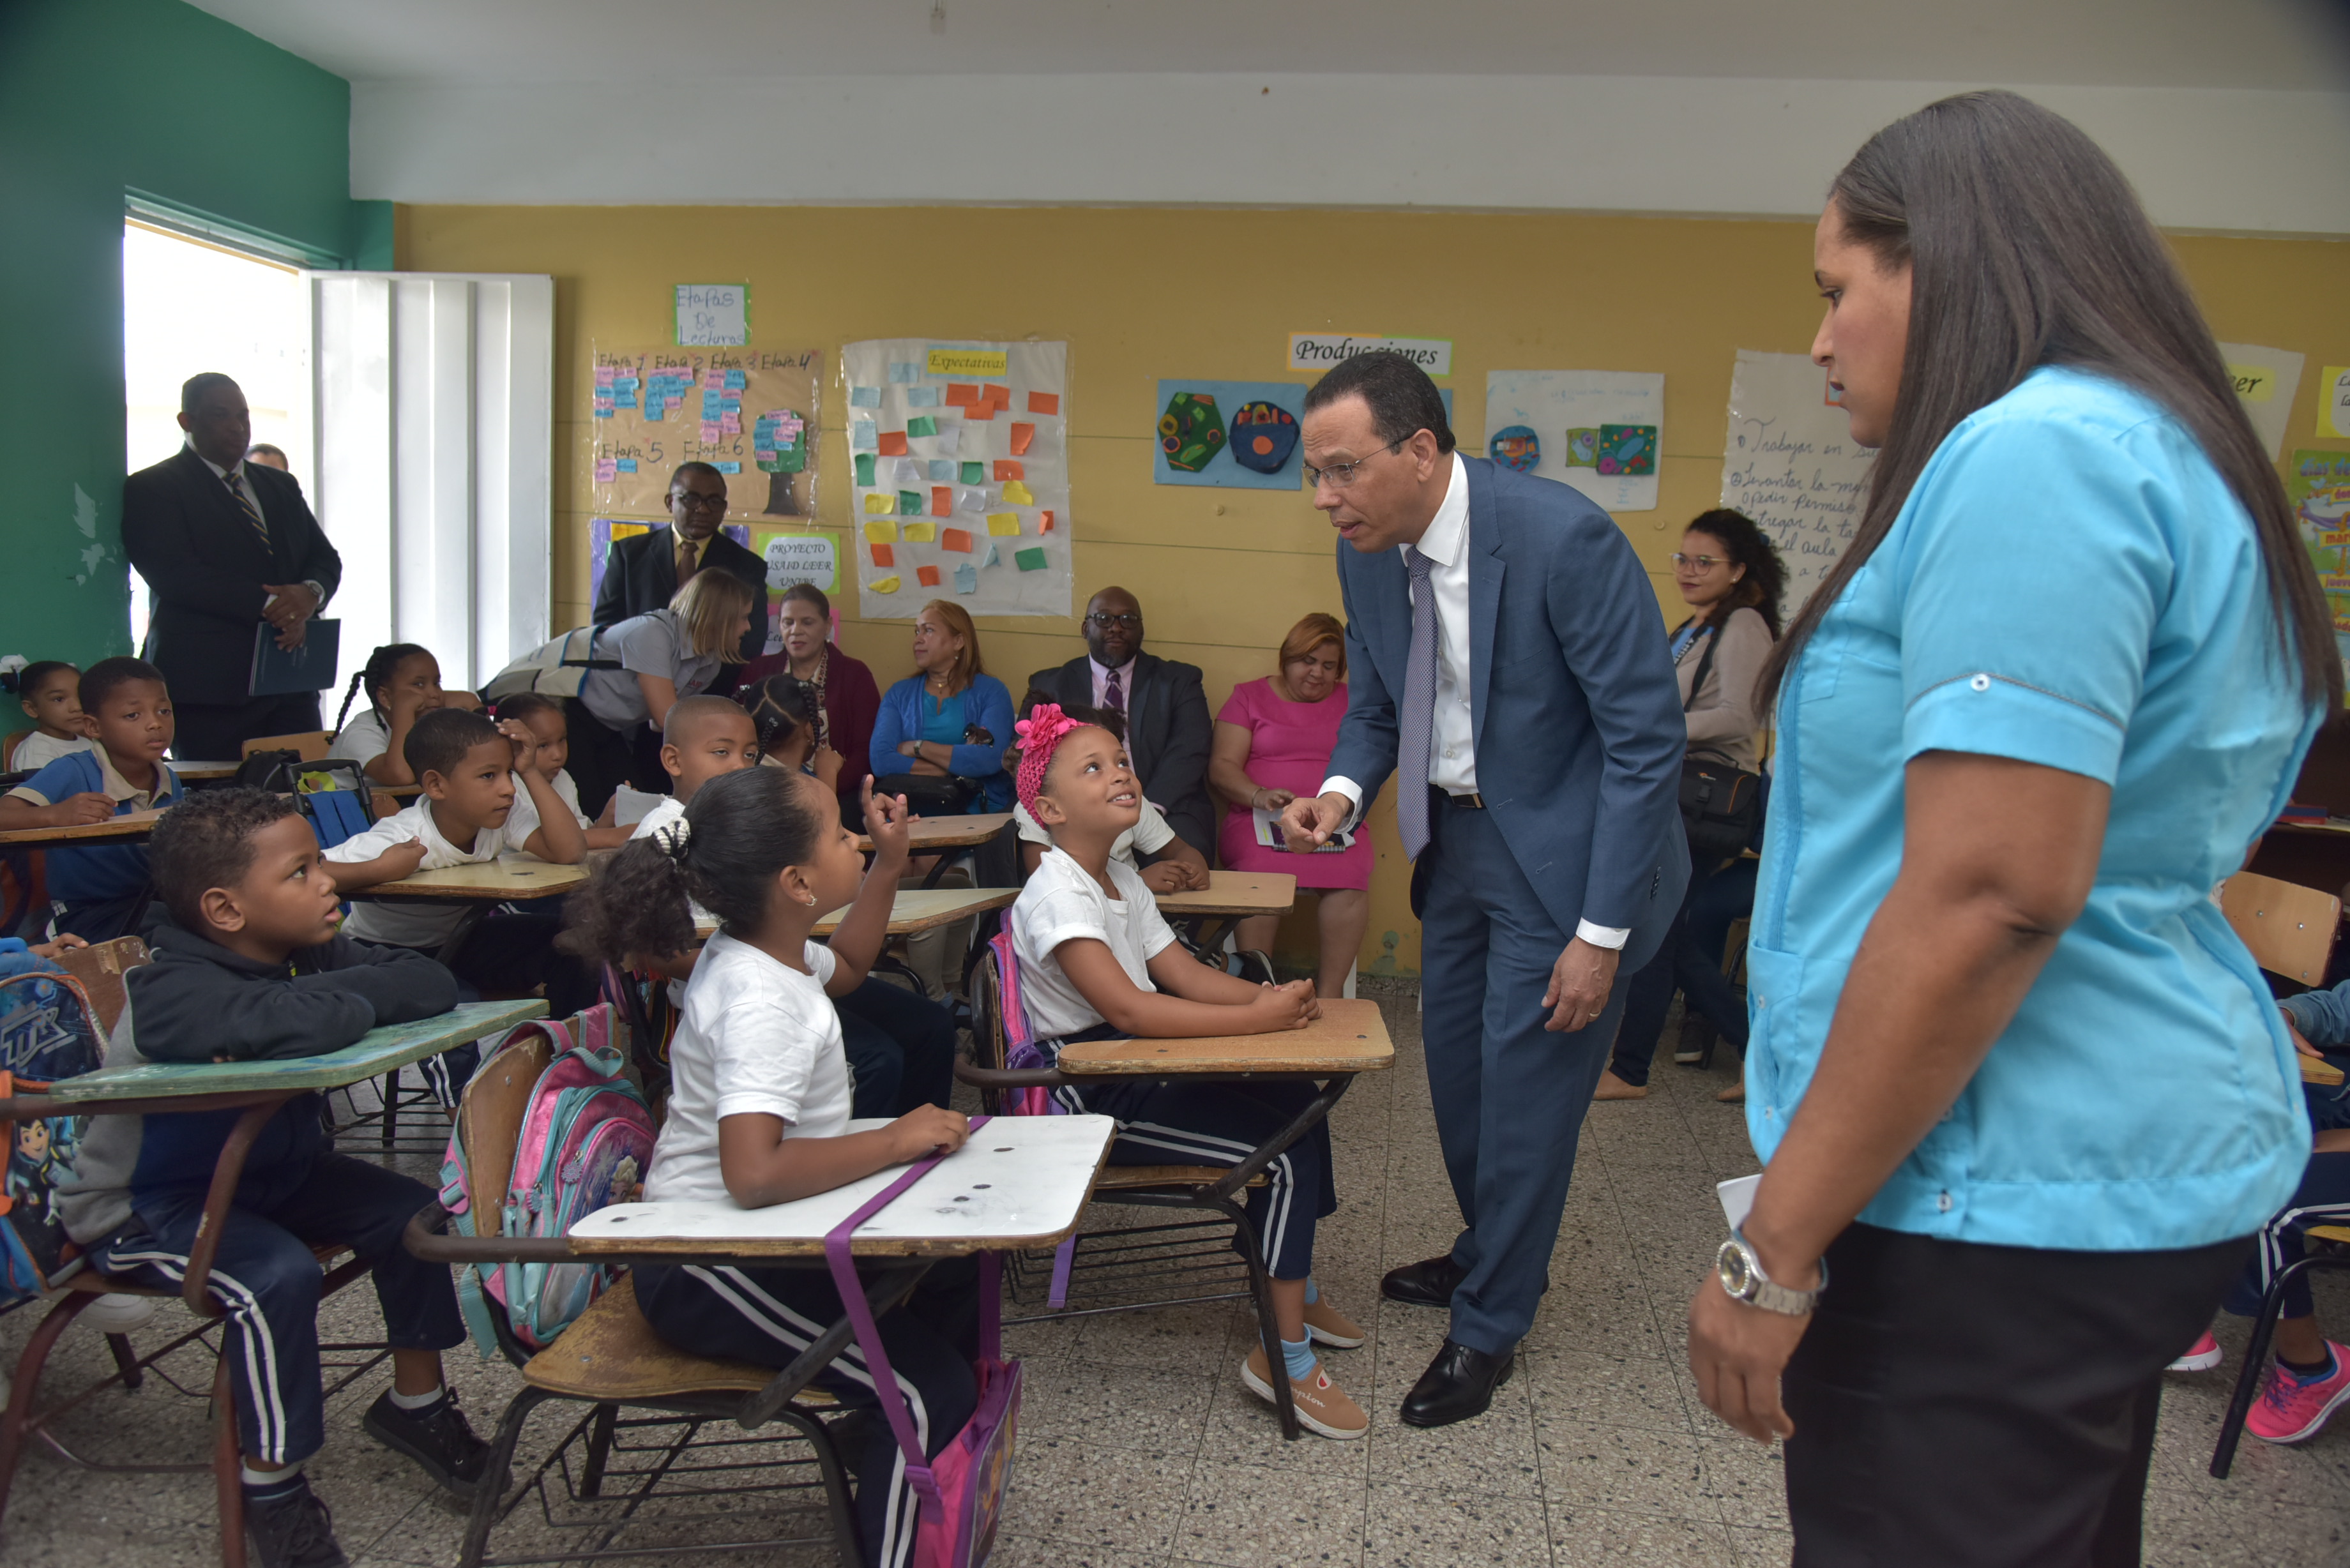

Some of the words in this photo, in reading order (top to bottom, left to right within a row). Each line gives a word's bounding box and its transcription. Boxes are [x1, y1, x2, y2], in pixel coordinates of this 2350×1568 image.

[676, 285, 734, 308] Etapas
[761, 352, 796, 370] Etapa
[800, 355, 812, 370] 4
[930, 354, 1006, 370] Expectativas
[603, 439, 644, 460] Etapa
[646, 442, 663, 464] 5
[733, 436, 744, 456] 6
[769, 543, 826, 555] PROYECTO
[801, 561, 834, 572] LEER
